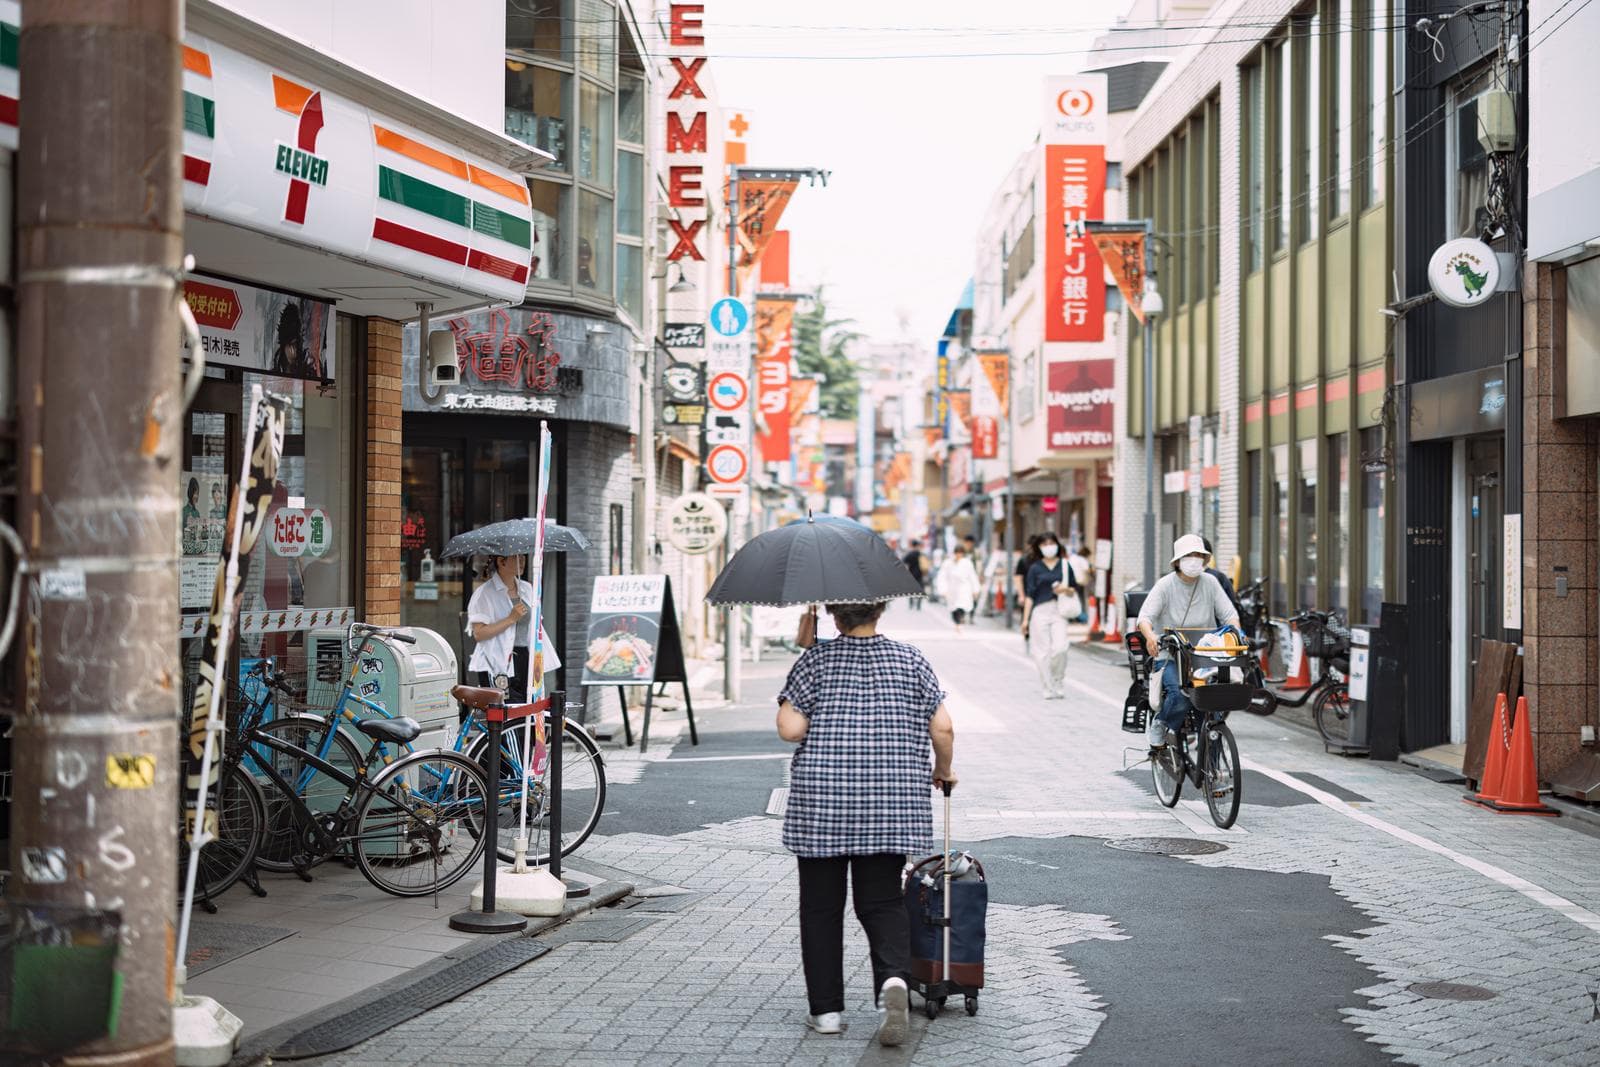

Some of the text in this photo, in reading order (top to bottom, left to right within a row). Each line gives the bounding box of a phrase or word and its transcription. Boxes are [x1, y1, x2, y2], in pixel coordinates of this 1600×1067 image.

[717, 456, 739, 473] 20
[274, 514, 323, 544] たばこ 酒
